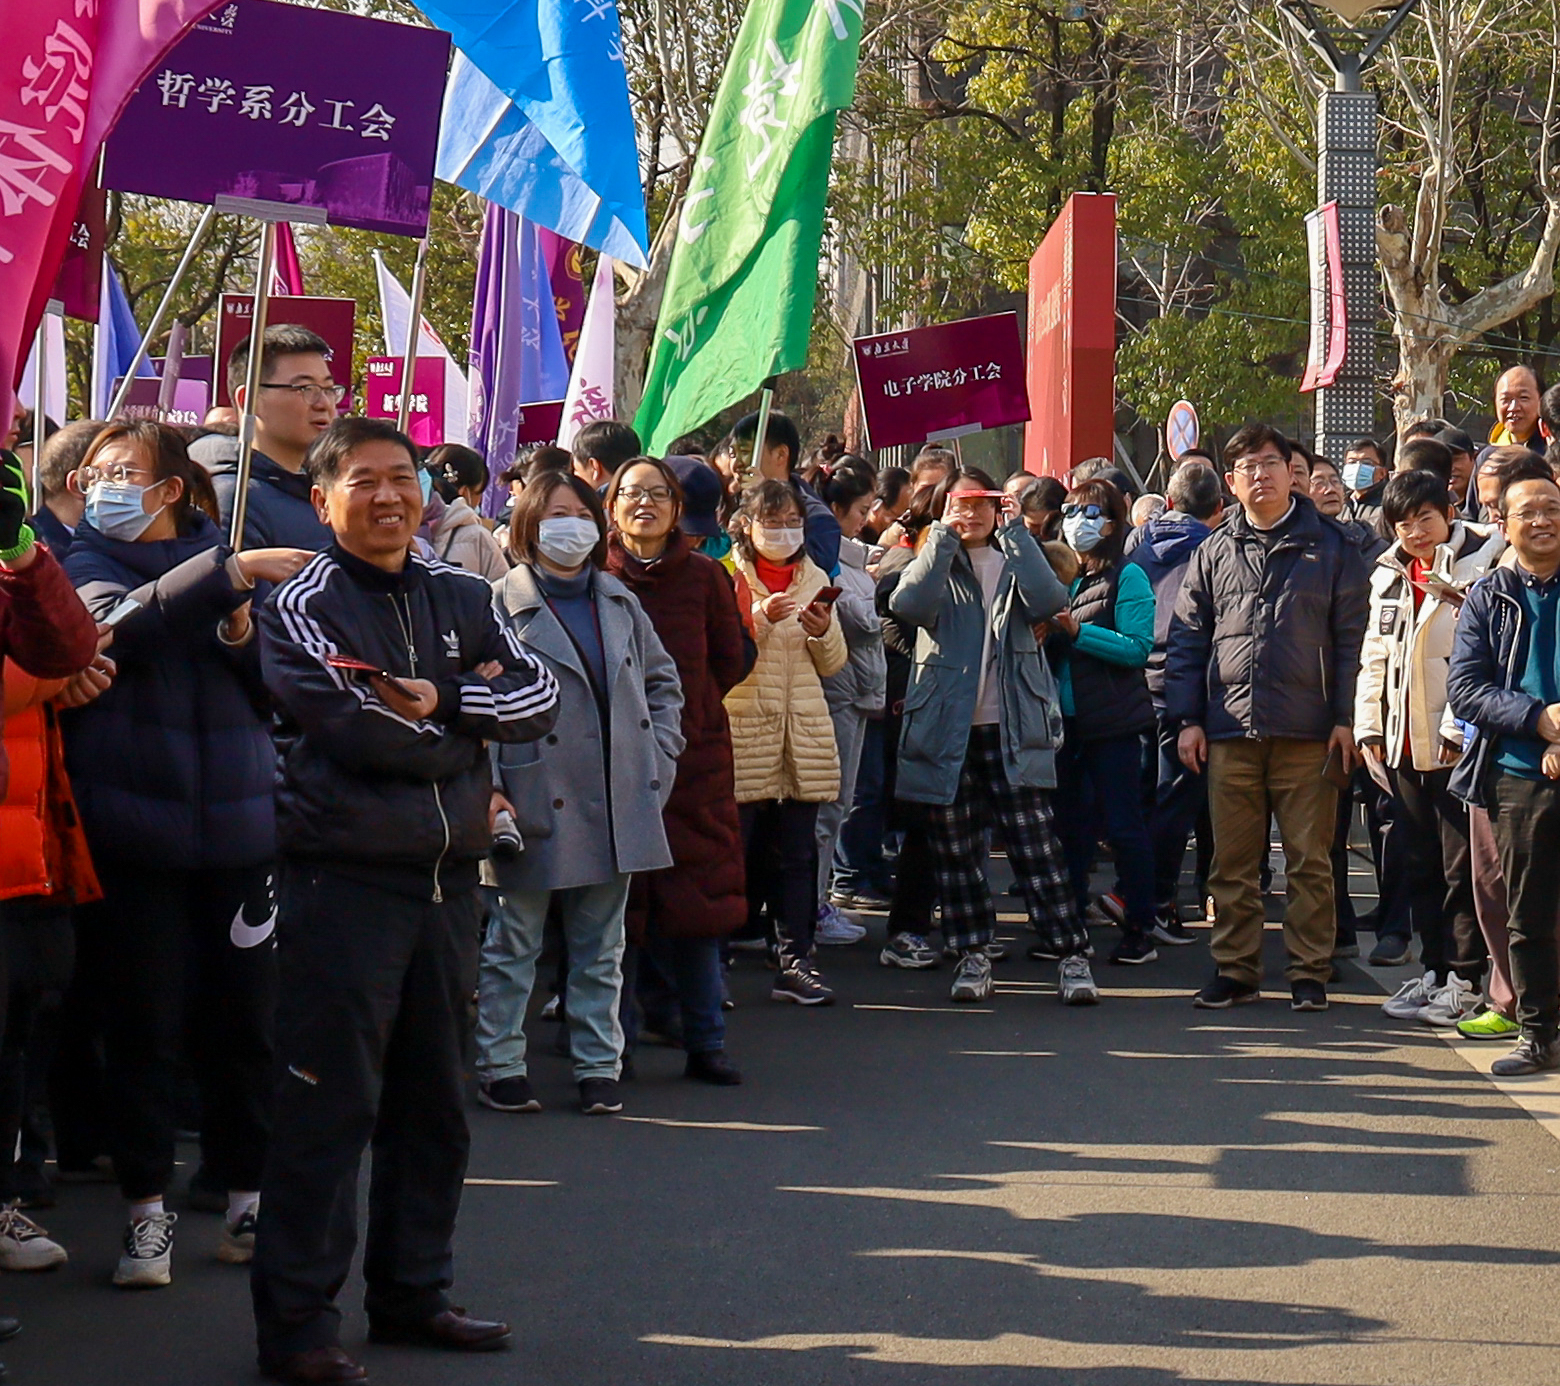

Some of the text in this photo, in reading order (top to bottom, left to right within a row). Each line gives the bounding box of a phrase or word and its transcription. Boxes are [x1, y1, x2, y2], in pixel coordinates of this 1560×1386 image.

[156, 69, 397, 142] 哲学系分工会
[883, 362, 1002, 397] 电子学院分工会
